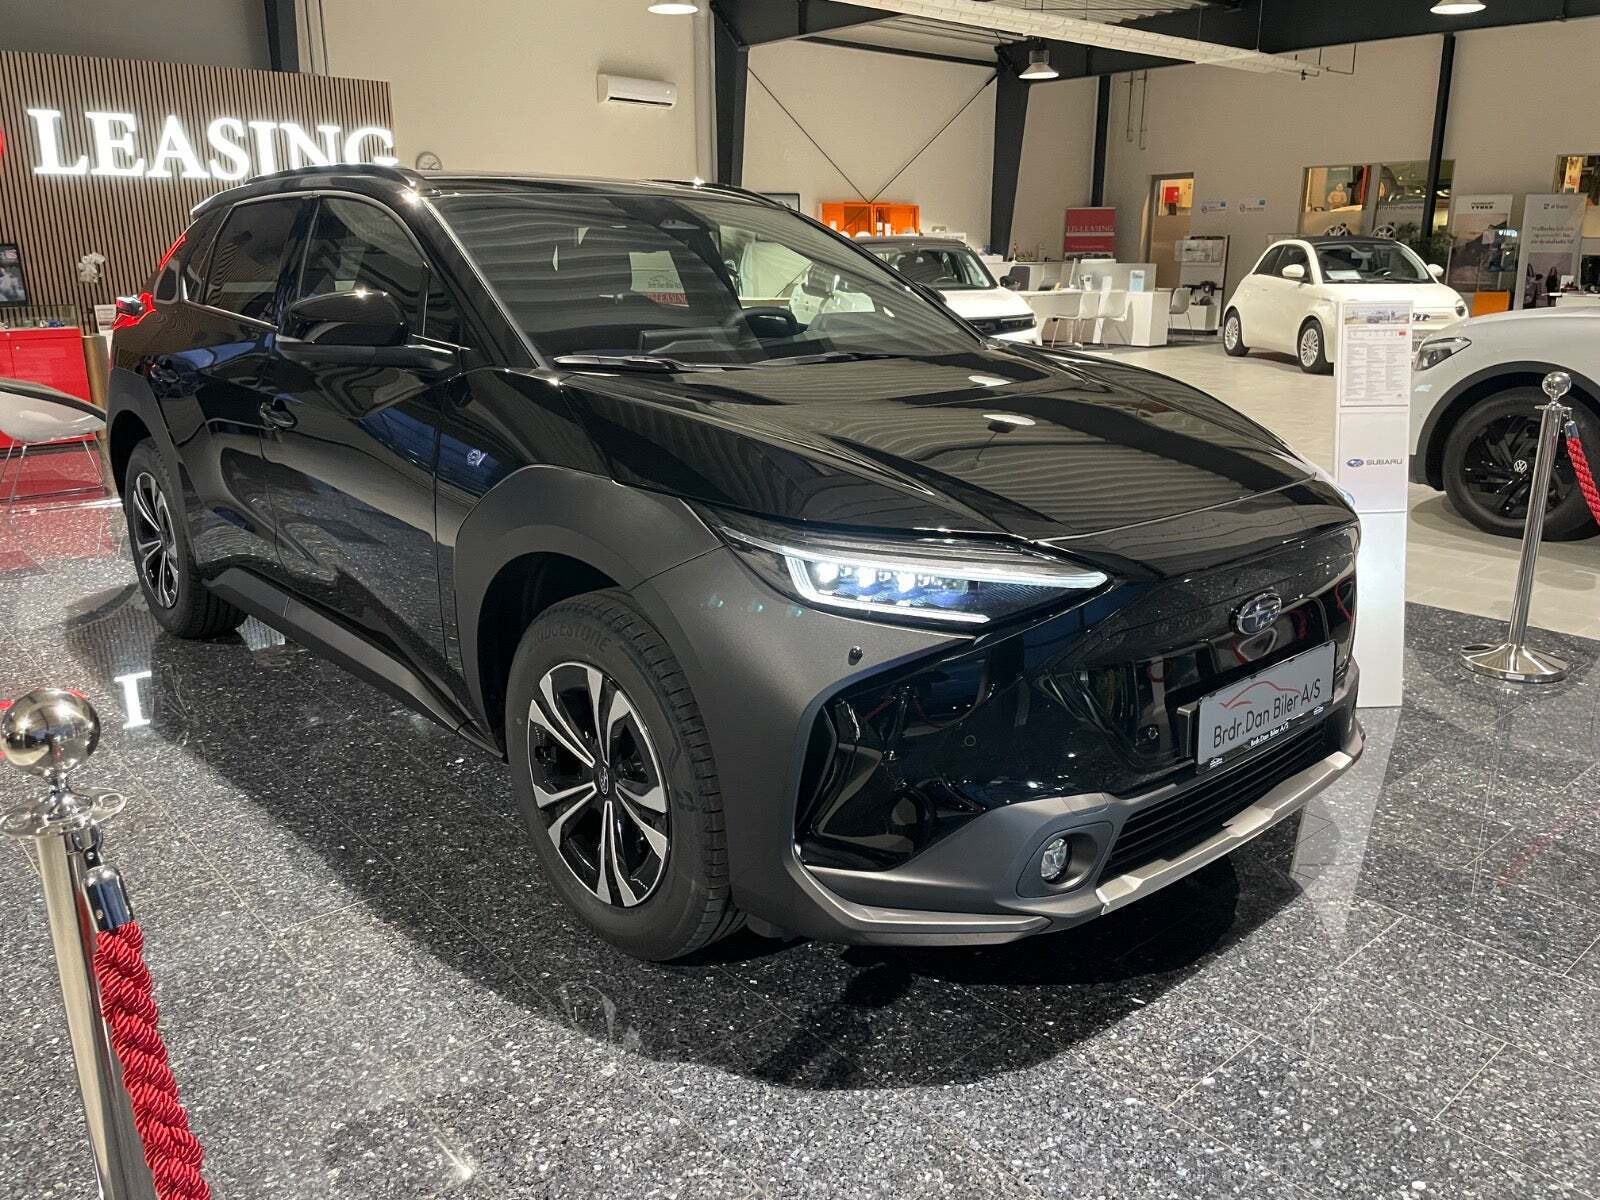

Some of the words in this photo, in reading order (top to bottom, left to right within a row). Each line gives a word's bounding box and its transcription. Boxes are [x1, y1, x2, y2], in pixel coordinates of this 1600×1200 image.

[27, 108, 398, 181] LEASING
[1366, 458, 1403, 466] SUBARU
[1273, 693, 1299, 719] Biler
[1301, 678, 1321, 706] A/S
